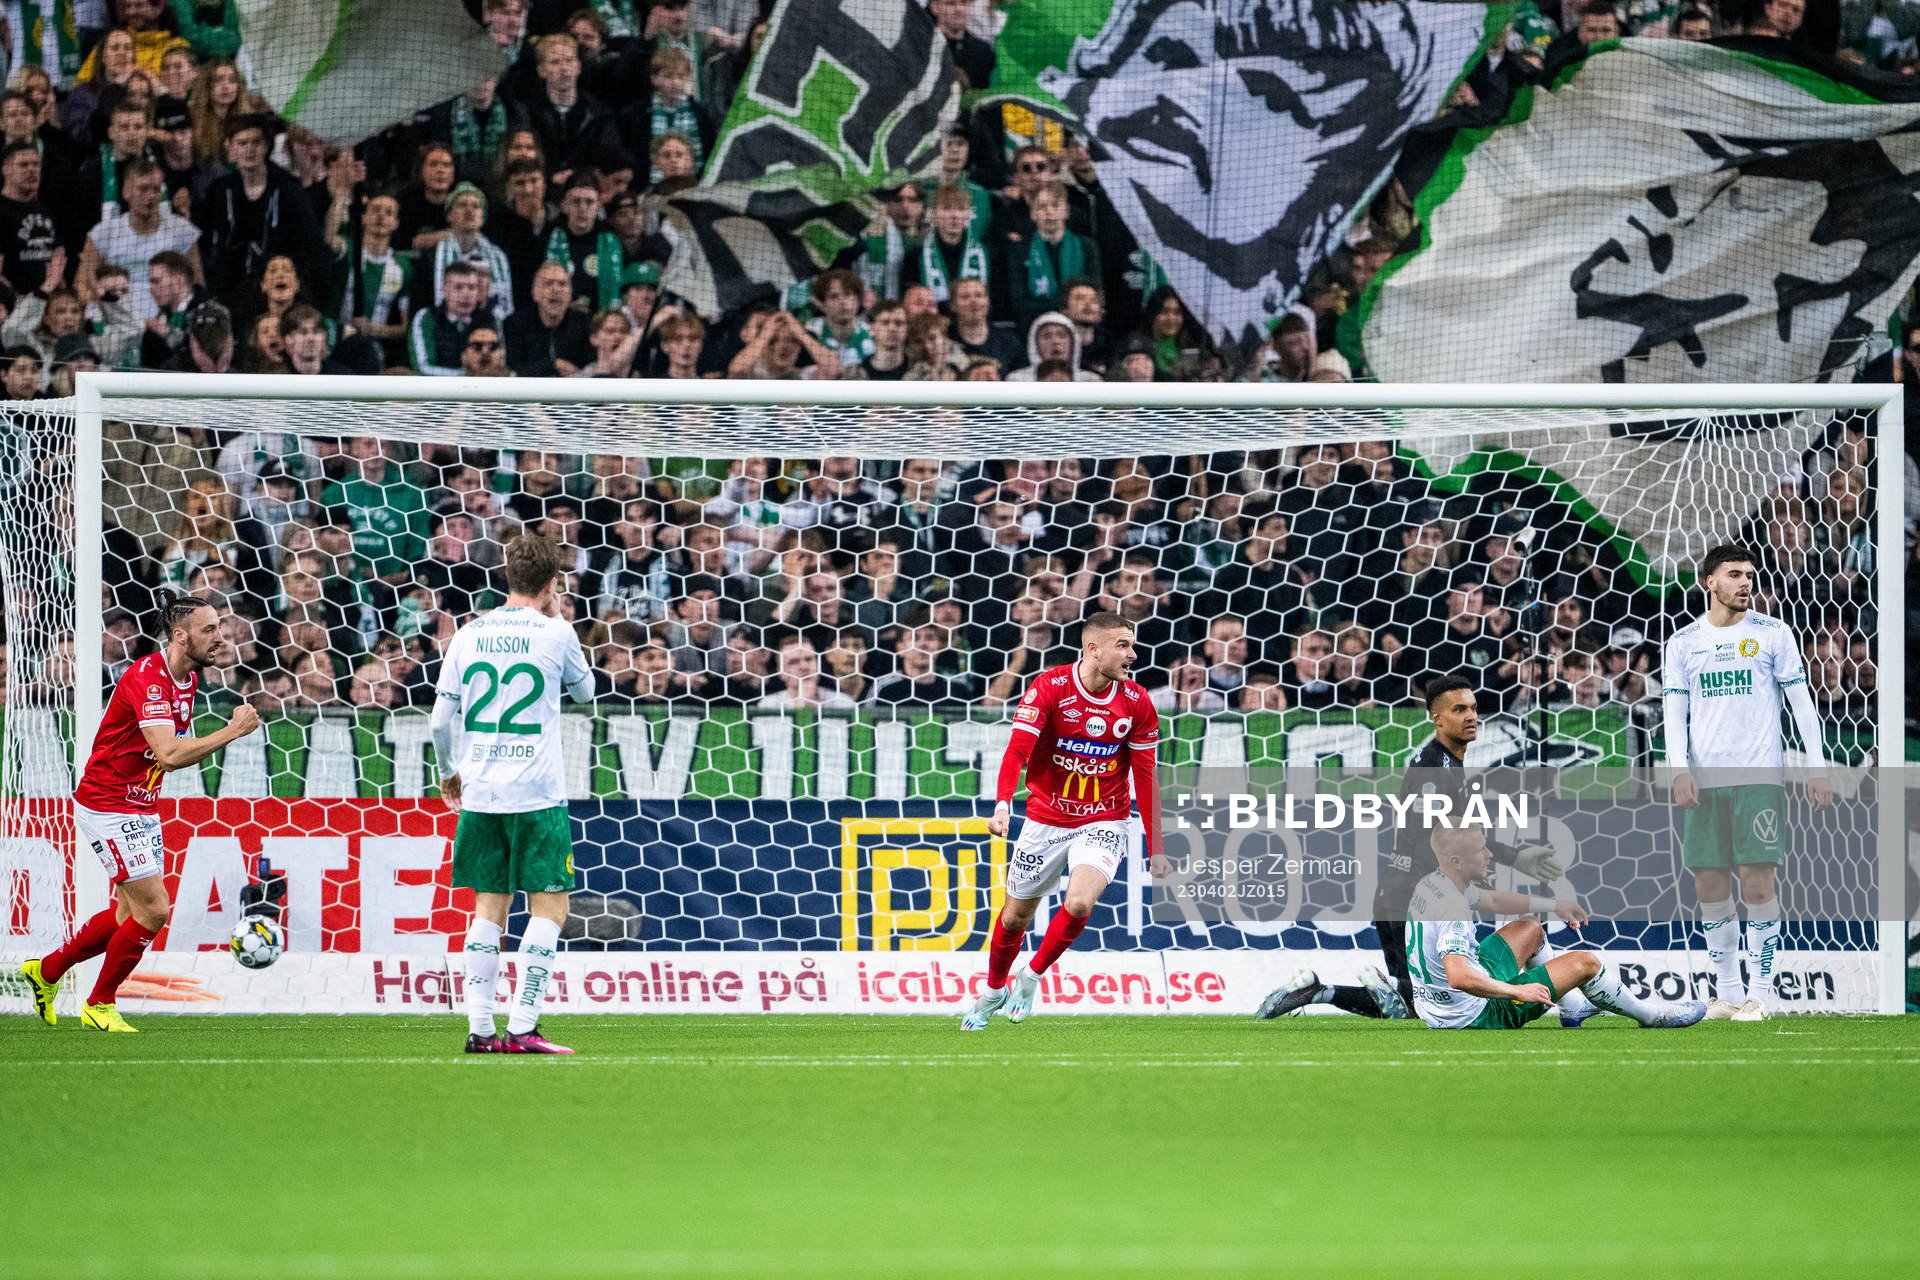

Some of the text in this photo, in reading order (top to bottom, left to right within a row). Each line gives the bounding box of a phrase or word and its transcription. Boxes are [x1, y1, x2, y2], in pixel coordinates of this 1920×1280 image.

[476, 636, 530, 654] NILSSON
[1699, 669, 1752, 689] HUSKI
[462, 661, 545, 735] 22
[1702, 687, 1753, 698] CHOCOLATE
[144, 704, 170, 713] UNIBET
[1085, 706, 1111, 716] Helmia
[1056, 738, 1120, 756] Helmia
[1052, 753, 1107, 775] askås
[134, 853, 147, 867] 10
[584, 960, 743, 1004] online
[758, 956, 828, 1011] på
